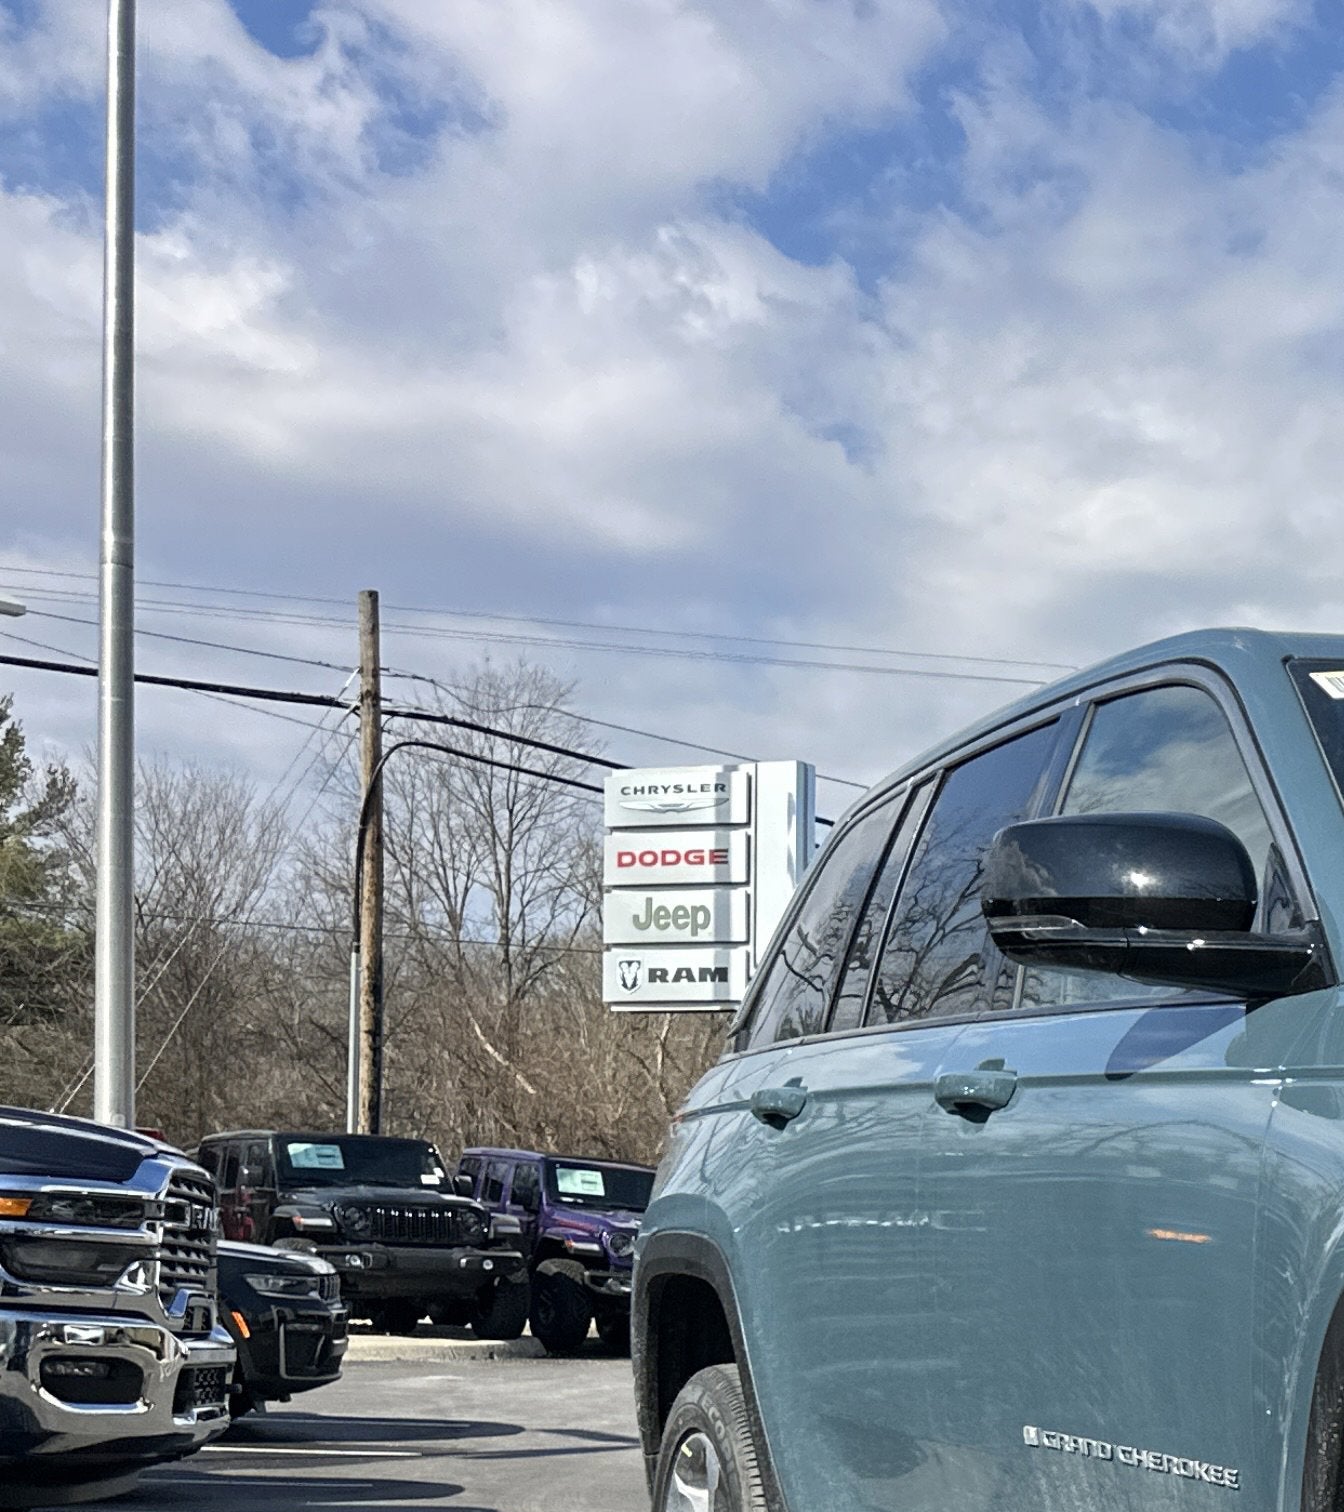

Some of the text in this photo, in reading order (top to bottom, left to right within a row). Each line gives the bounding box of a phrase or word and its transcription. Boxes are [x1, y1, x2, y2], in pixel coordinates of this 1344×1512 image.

[620, 783, 727, 796] CHRYSLER
[616, 849, 729, 868] DODGE
[632, 897, 711, 936] Jeep
[648, 967, 729, 983] RAM
[1043, 1430, 1240, 1490] GRAND CHEROKEE
